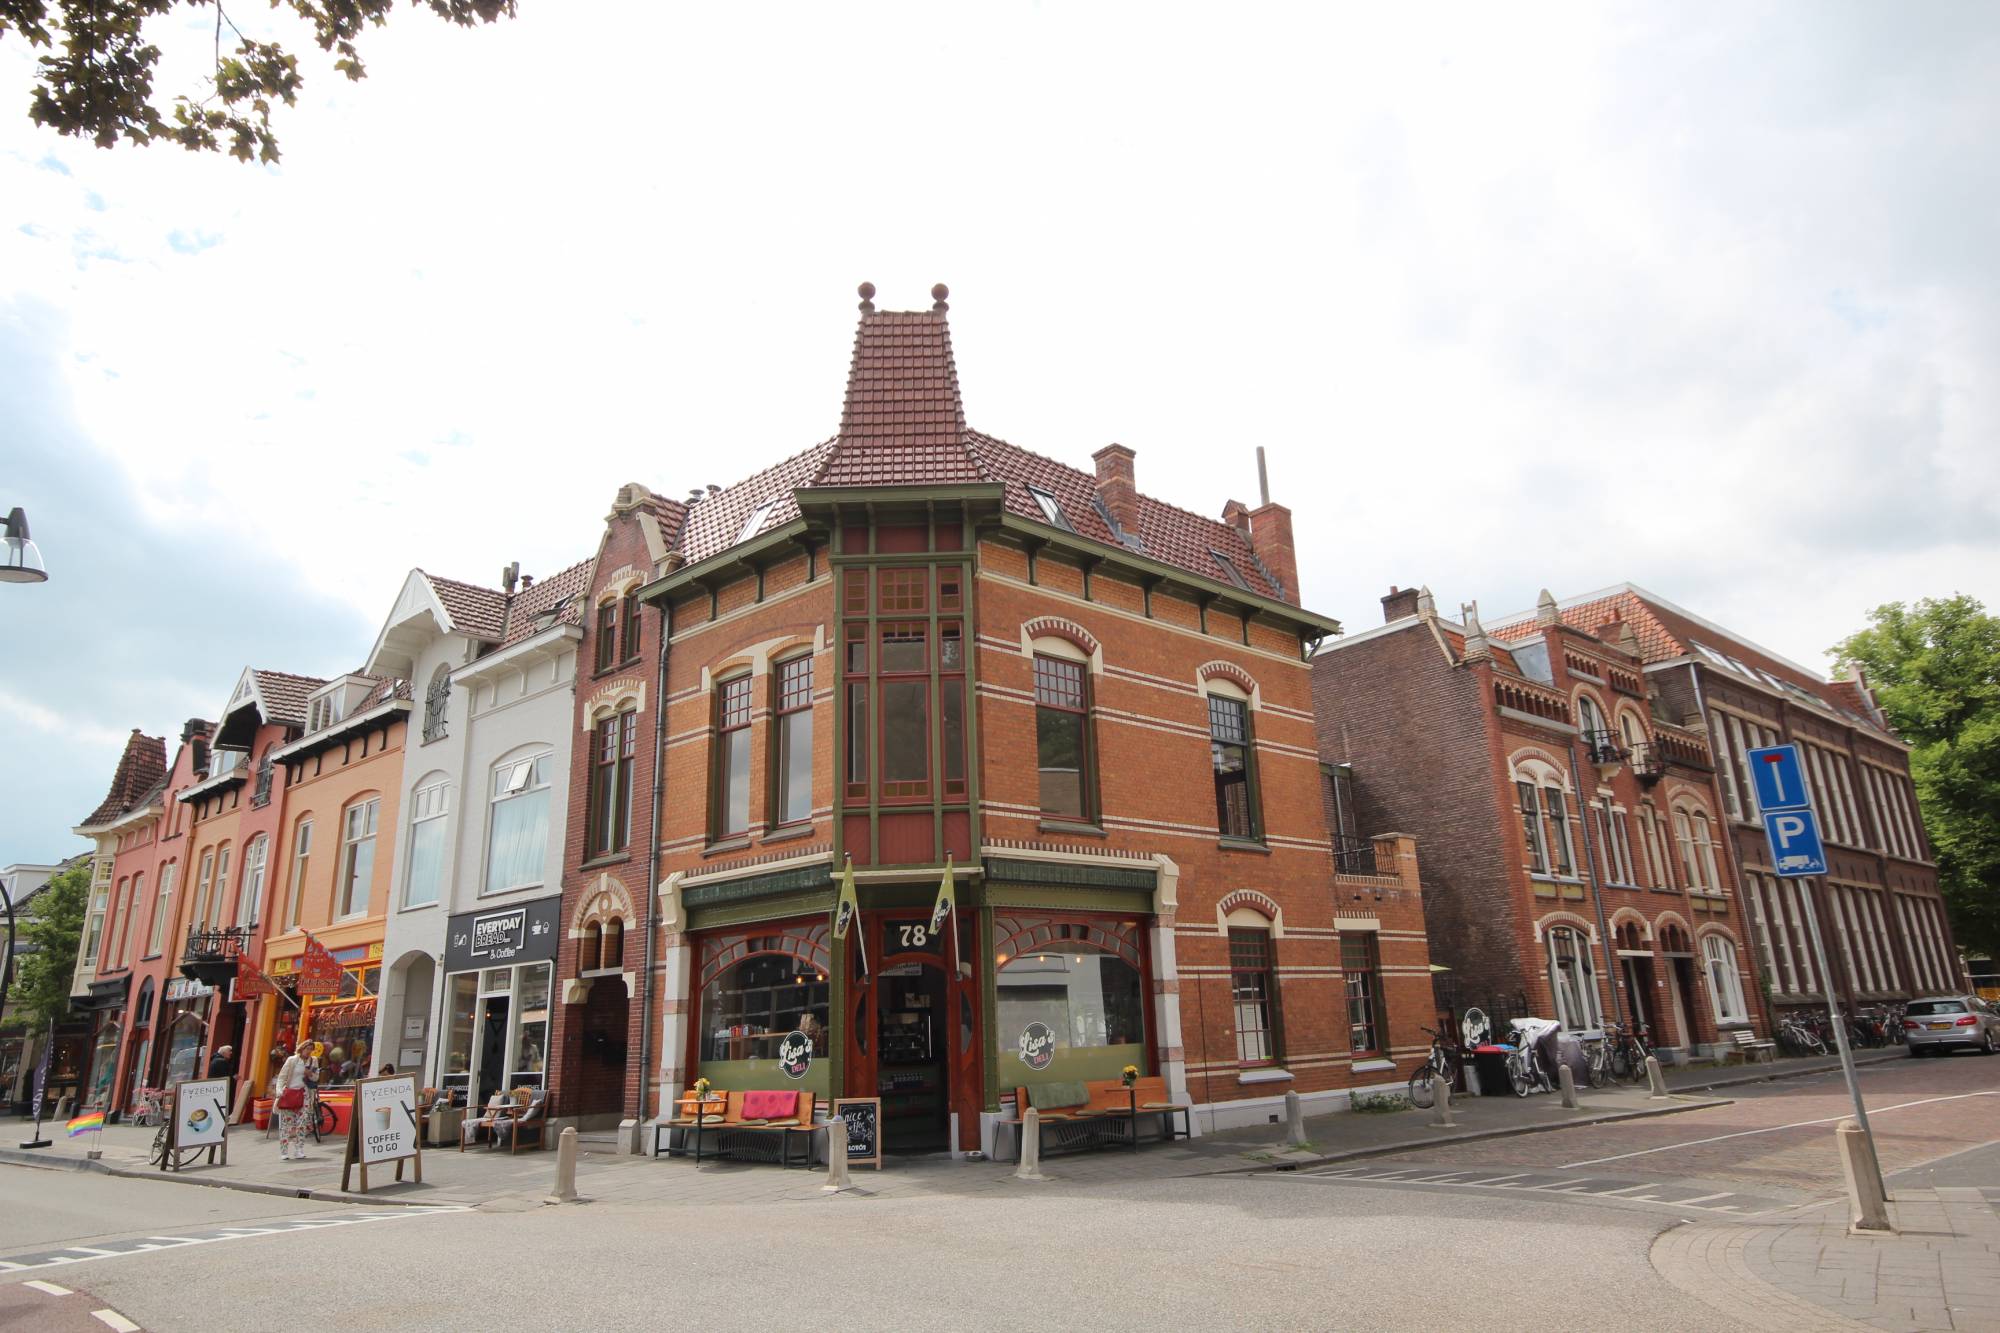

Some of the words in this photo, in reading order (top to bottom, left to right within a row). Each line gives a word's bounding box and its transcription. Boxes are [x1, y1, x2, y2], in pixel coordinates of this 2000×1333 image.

[1775, 816, 1805, 848] P
[476, 915, 522, 935] EVERYDAY
[900, 924, 927, 947] 78
[489, 949, 497, 960] &
[496, 946, 516, 960] Coffee
[779, 1038, 813, 1069] Lisa's
[1019, 1030, 1055, 1060] Lisa's
[1033, 1052, 1049, 1064] DELI
[791, 1062, 806, 1073] DELI
[367, 1132, 401, 1144] COFFEE
[371, 1145, 383, 1154] TO
[385, 1142, 398, 1152] GO
